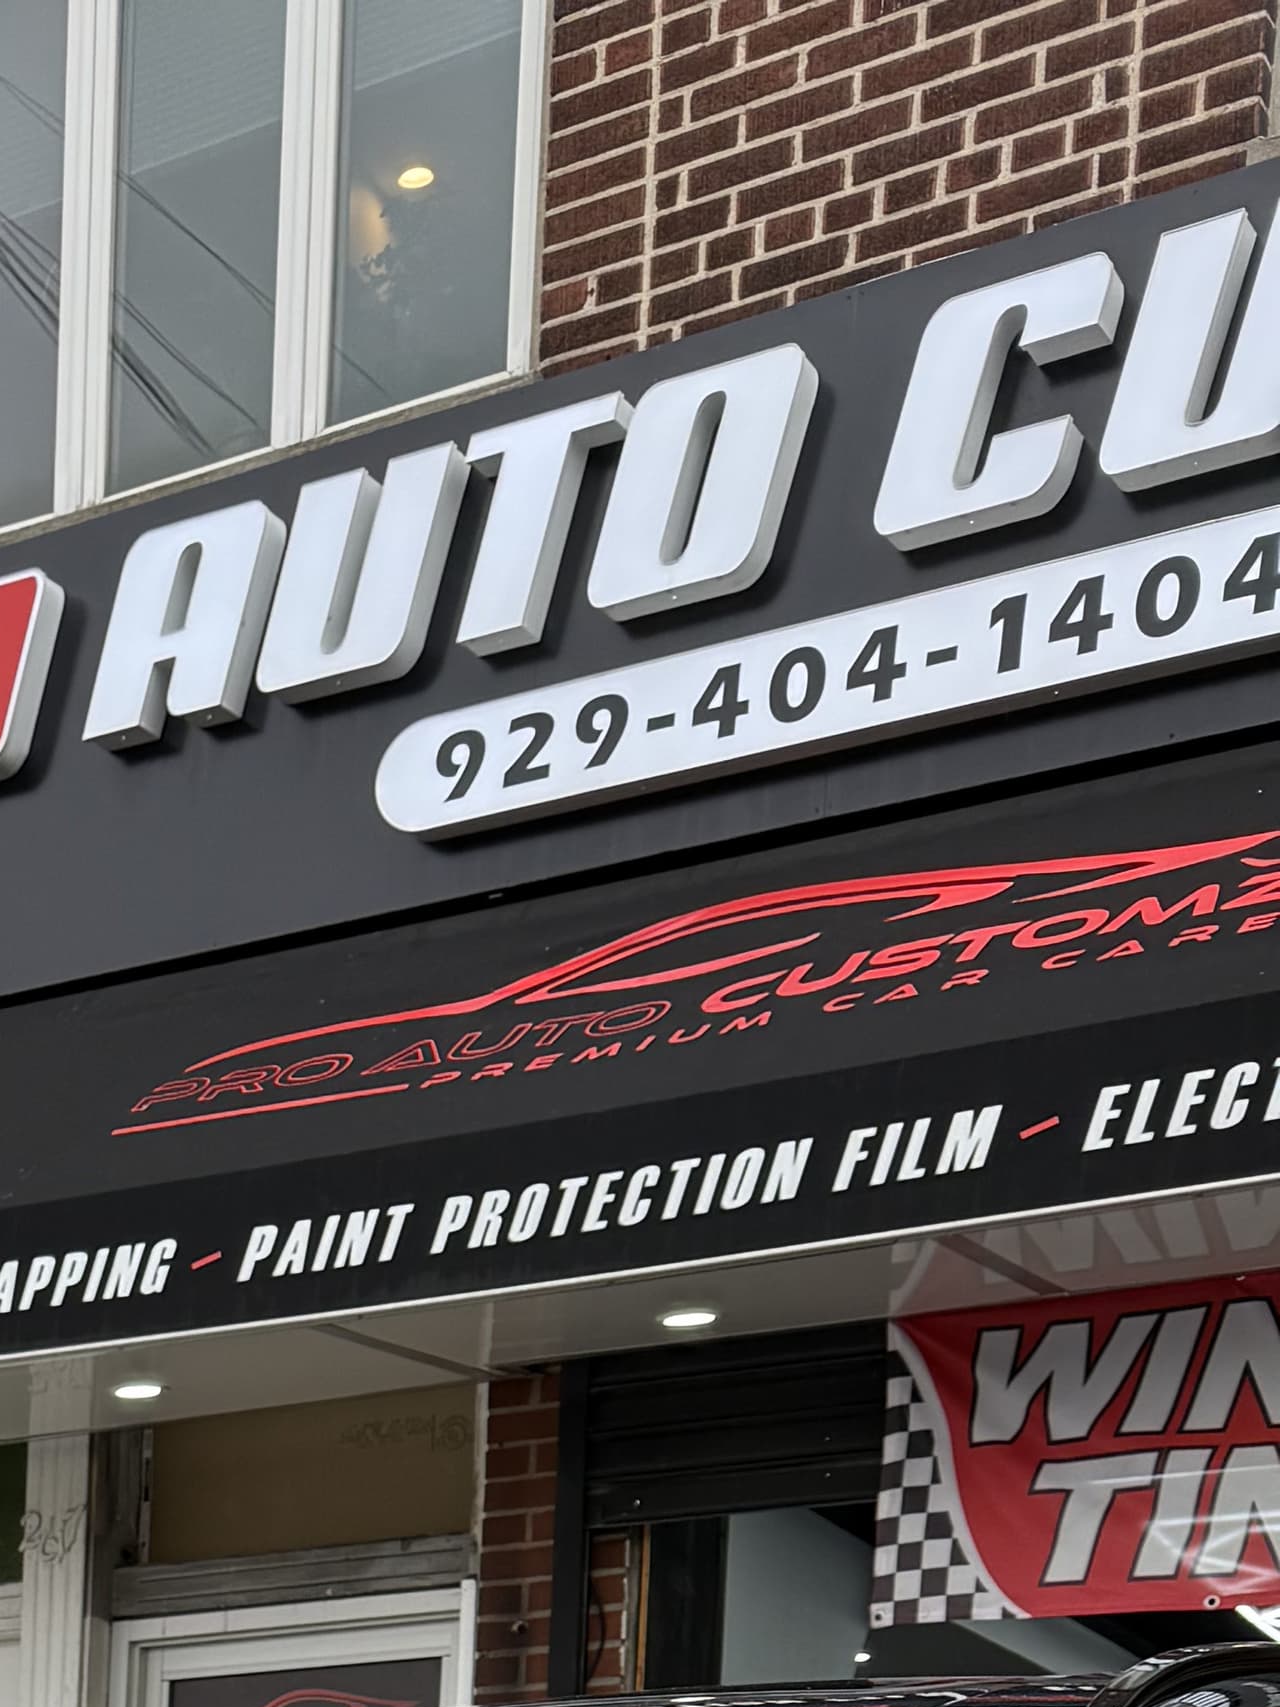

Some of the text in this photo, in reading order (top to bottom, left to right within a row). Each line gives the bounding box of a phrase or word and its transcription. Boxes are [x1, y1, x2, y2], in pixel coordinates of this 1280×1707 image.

[83, 343, 820, 753] AUTO
[435, 533, 1280, 803] 929-404-1404
[132, 1053, 353, 1113] PRO
[361, 1001, 673, 1076] AUTO
[421, 911, 1280, 1089] PREMIUM CAR CARE
[238, 1203, 415, 1283] PAINT
[431, 1136, 810, 1254] PROTECTION
[832, 1105, 1004, 1193] FILM
[1081, 1057, 1280, 1153] ELEC
